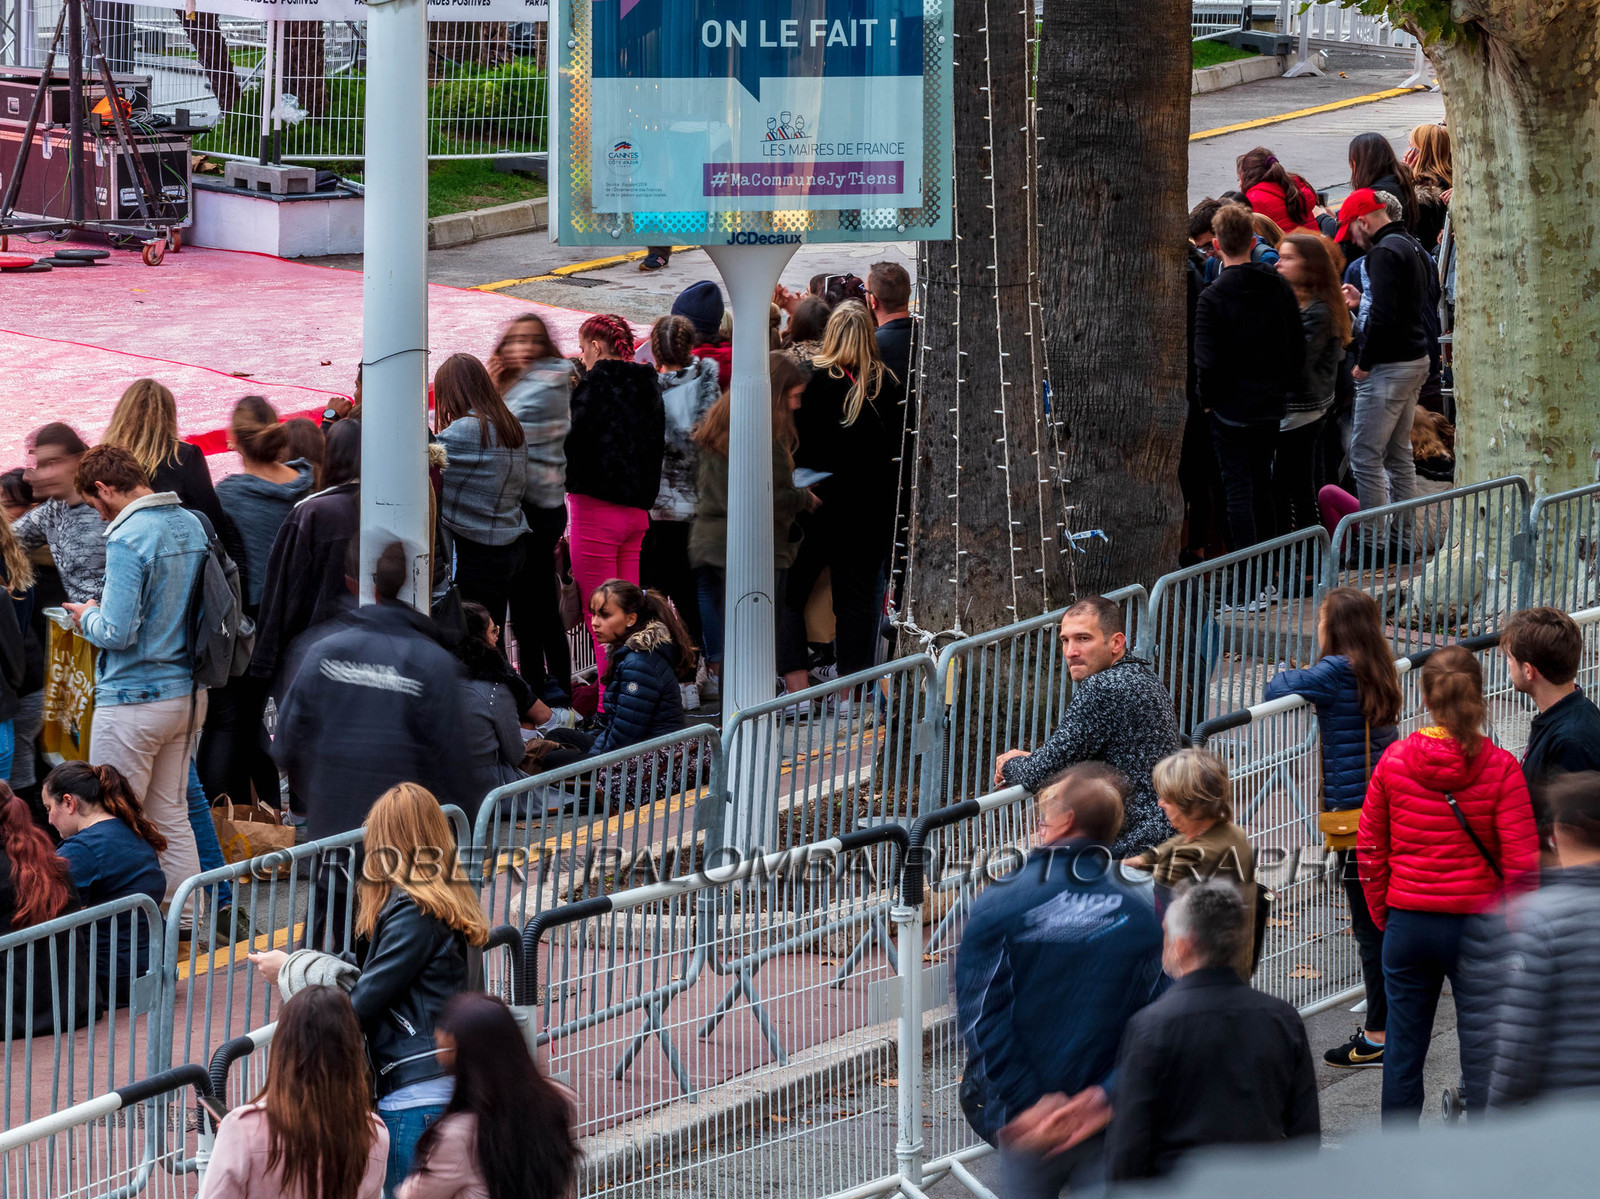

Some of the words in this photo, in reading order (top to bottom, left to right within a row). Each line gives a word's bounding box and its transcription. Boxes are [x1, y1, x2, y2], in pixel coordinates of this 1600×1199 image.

[701, 19, 747, 47] ON
[759, 19, 798, 47] LE
[810, 18, 878, 47] FAIT
[889, 18, 897, 46] !
[762, 143, 786, 156] LES
[788, 142, 834, 156] MAIRES
[838, 142, 854, 156] DE
[856, 141, 905, 155] FRANCE
[727, 231, 803, 245] JCDecaux
